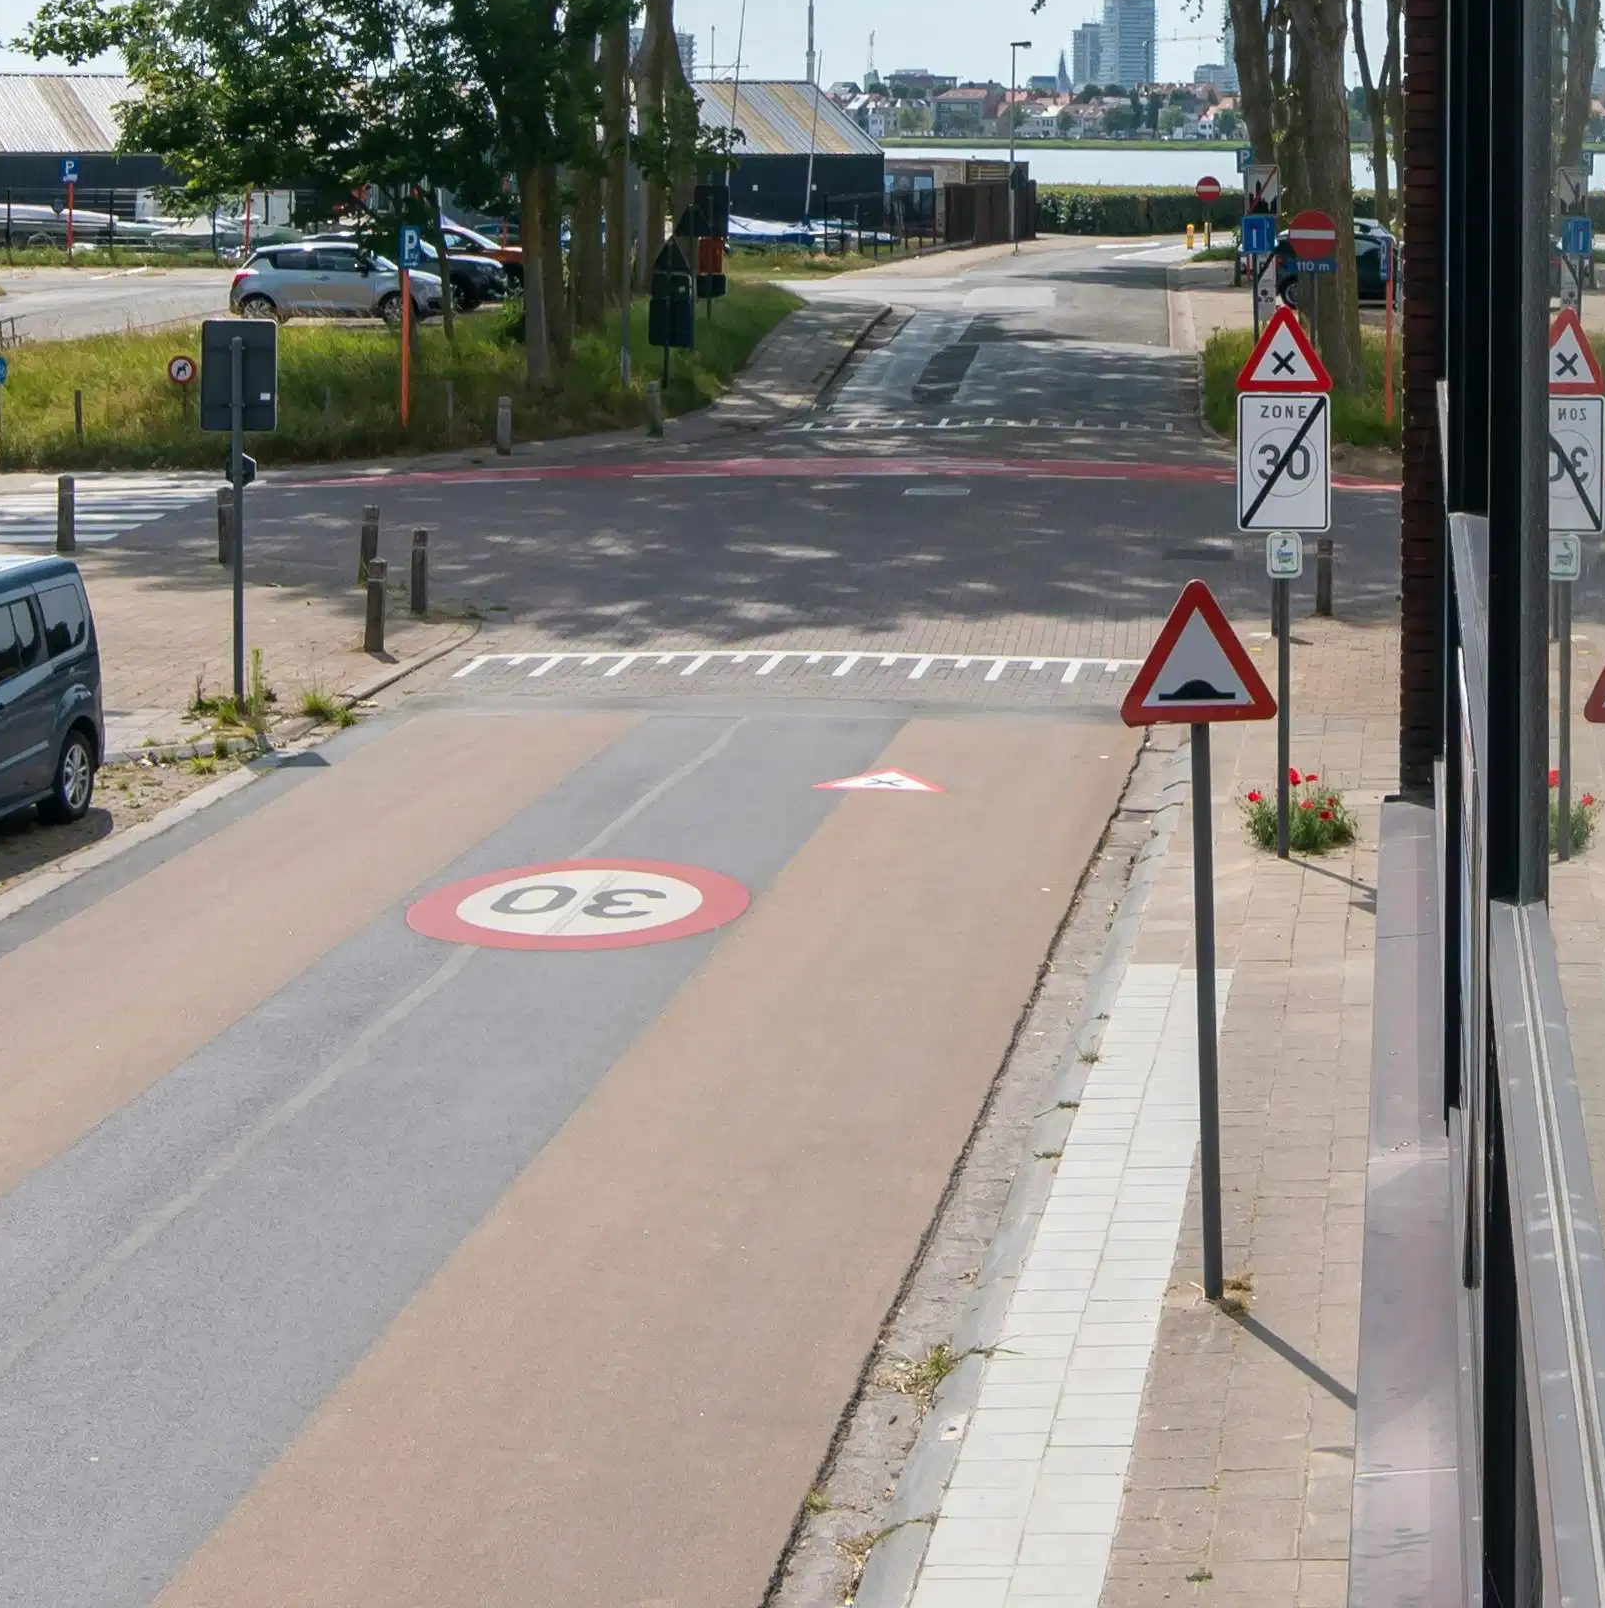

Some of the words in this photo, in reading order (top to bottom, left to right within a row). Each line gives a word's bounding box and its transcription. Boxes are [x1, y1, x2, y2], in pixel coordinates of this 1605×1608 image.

[1240, 149, 1250, 164] P
[65, 160, 75, 175] P
[404, 229, 418, 260] P
[1296, 260, 1314, 272] 110
[1318, 262, 1330, 272] m
[1260, 404, 1308, 419] ZONE
[1257, 443, 1311, 481] 30
[490, 884, 667, 919] 30
